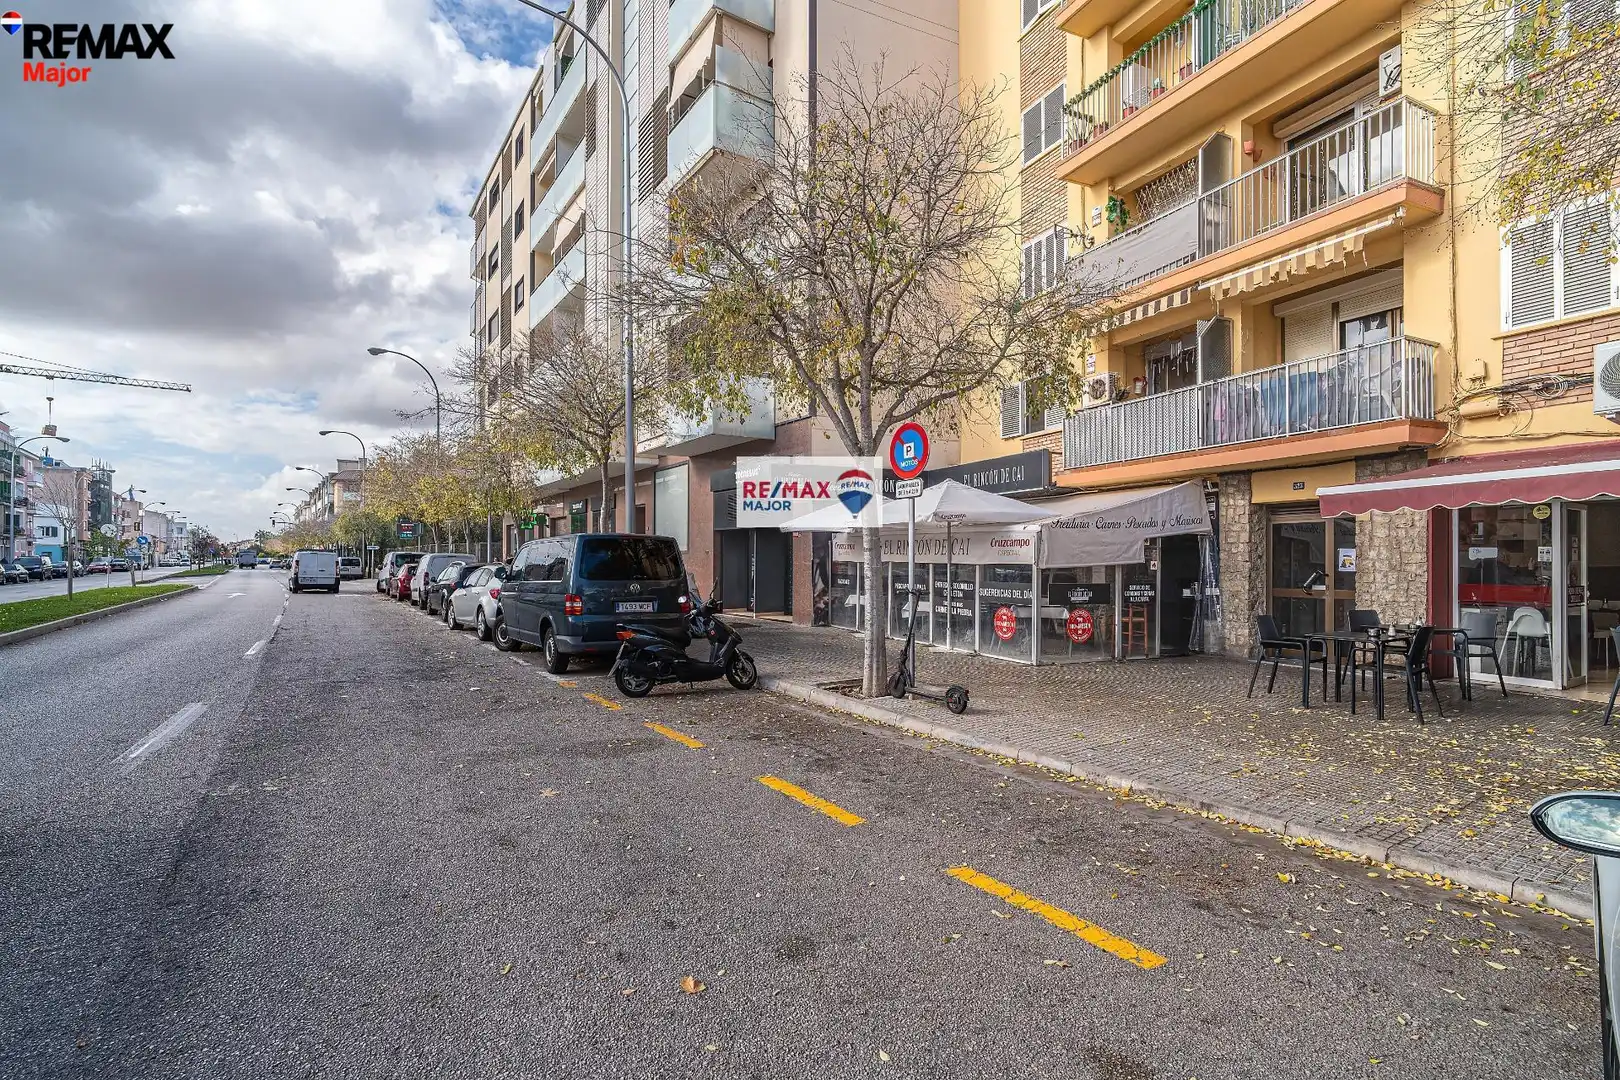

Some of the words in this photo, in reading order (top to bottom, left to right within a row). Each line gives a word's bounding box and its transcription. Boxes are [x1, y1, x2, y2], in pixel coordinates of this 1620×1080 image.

[906, 445, 912, 456] P
[900, 459, 919, 467] MOTOS
[973, 468, 999, 487] RINCÓN
[1000, 468, 1010, 483] DE
[1012, 465, 1024, 481] CAI
[1095, 516, 1122, 530] Carnes
[1125, 516, 1159, 529] Pescados
[1160, 519, 1167, 531] y
[1169, 514, 1204, 527] Mariscos
[883, 539, 895, 555] EL
[934, 539, 948, 555] DE
[950, 537, 971, 556] CAI
[990, 537, 1031, 549] Cruzcampo
[979, 587, 1012, 598] SUGERENCIAS
[1013, 589, 1023, 598] DEL
[1023, 588, 1033, 599] DÍA
